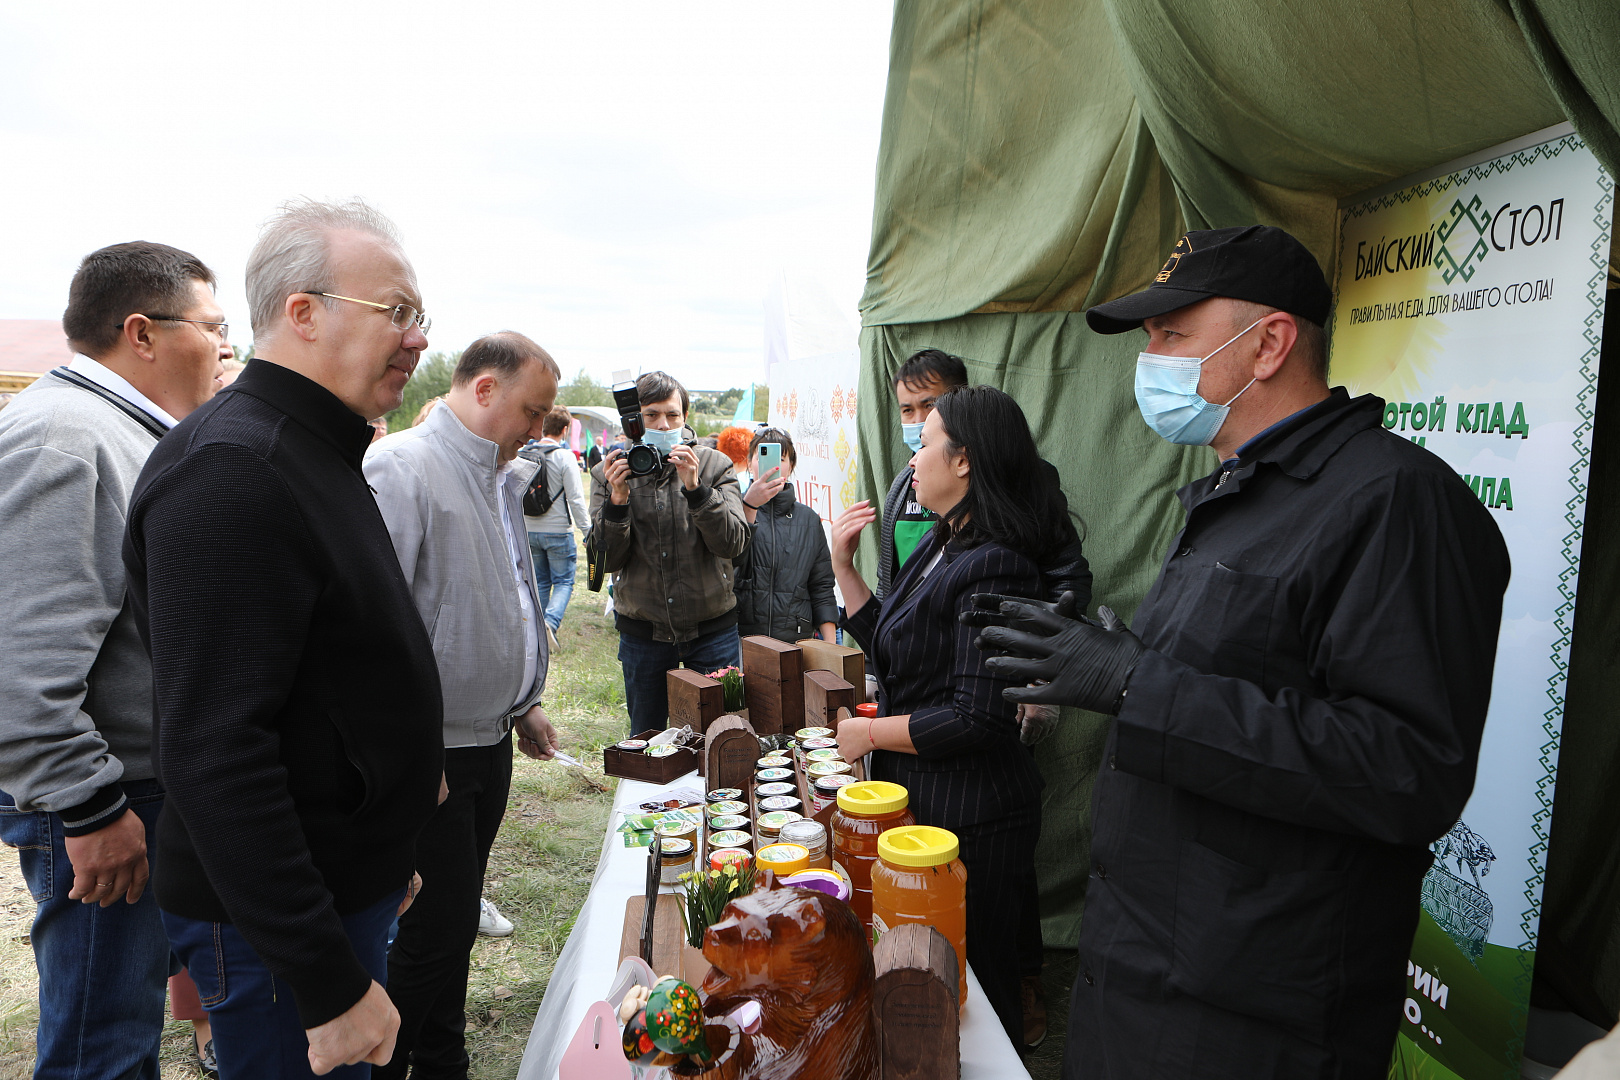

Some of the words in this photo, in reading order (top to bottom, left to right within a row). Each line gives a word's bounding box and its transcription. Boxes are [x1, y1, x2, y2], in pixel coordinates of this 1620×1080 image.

[1349, 301, 1404, 326] ПРАВИЛЬНАЯ
[1405, 298, 1424, 319] ЕДА
[1426, 293, 1450, 317] ДЛЯ
[1452, 287, 1501, 312] ВАШЕГО
[1504, 278, 1554, 305] СТОЛА!
[1383, 396, 1447, 432] ОТОЙ
[1456, 402, 1529, 439] КЛАД
[796, 475, 833, 525] МЁД
[1458, 474, 1513, 511] ИЛА
